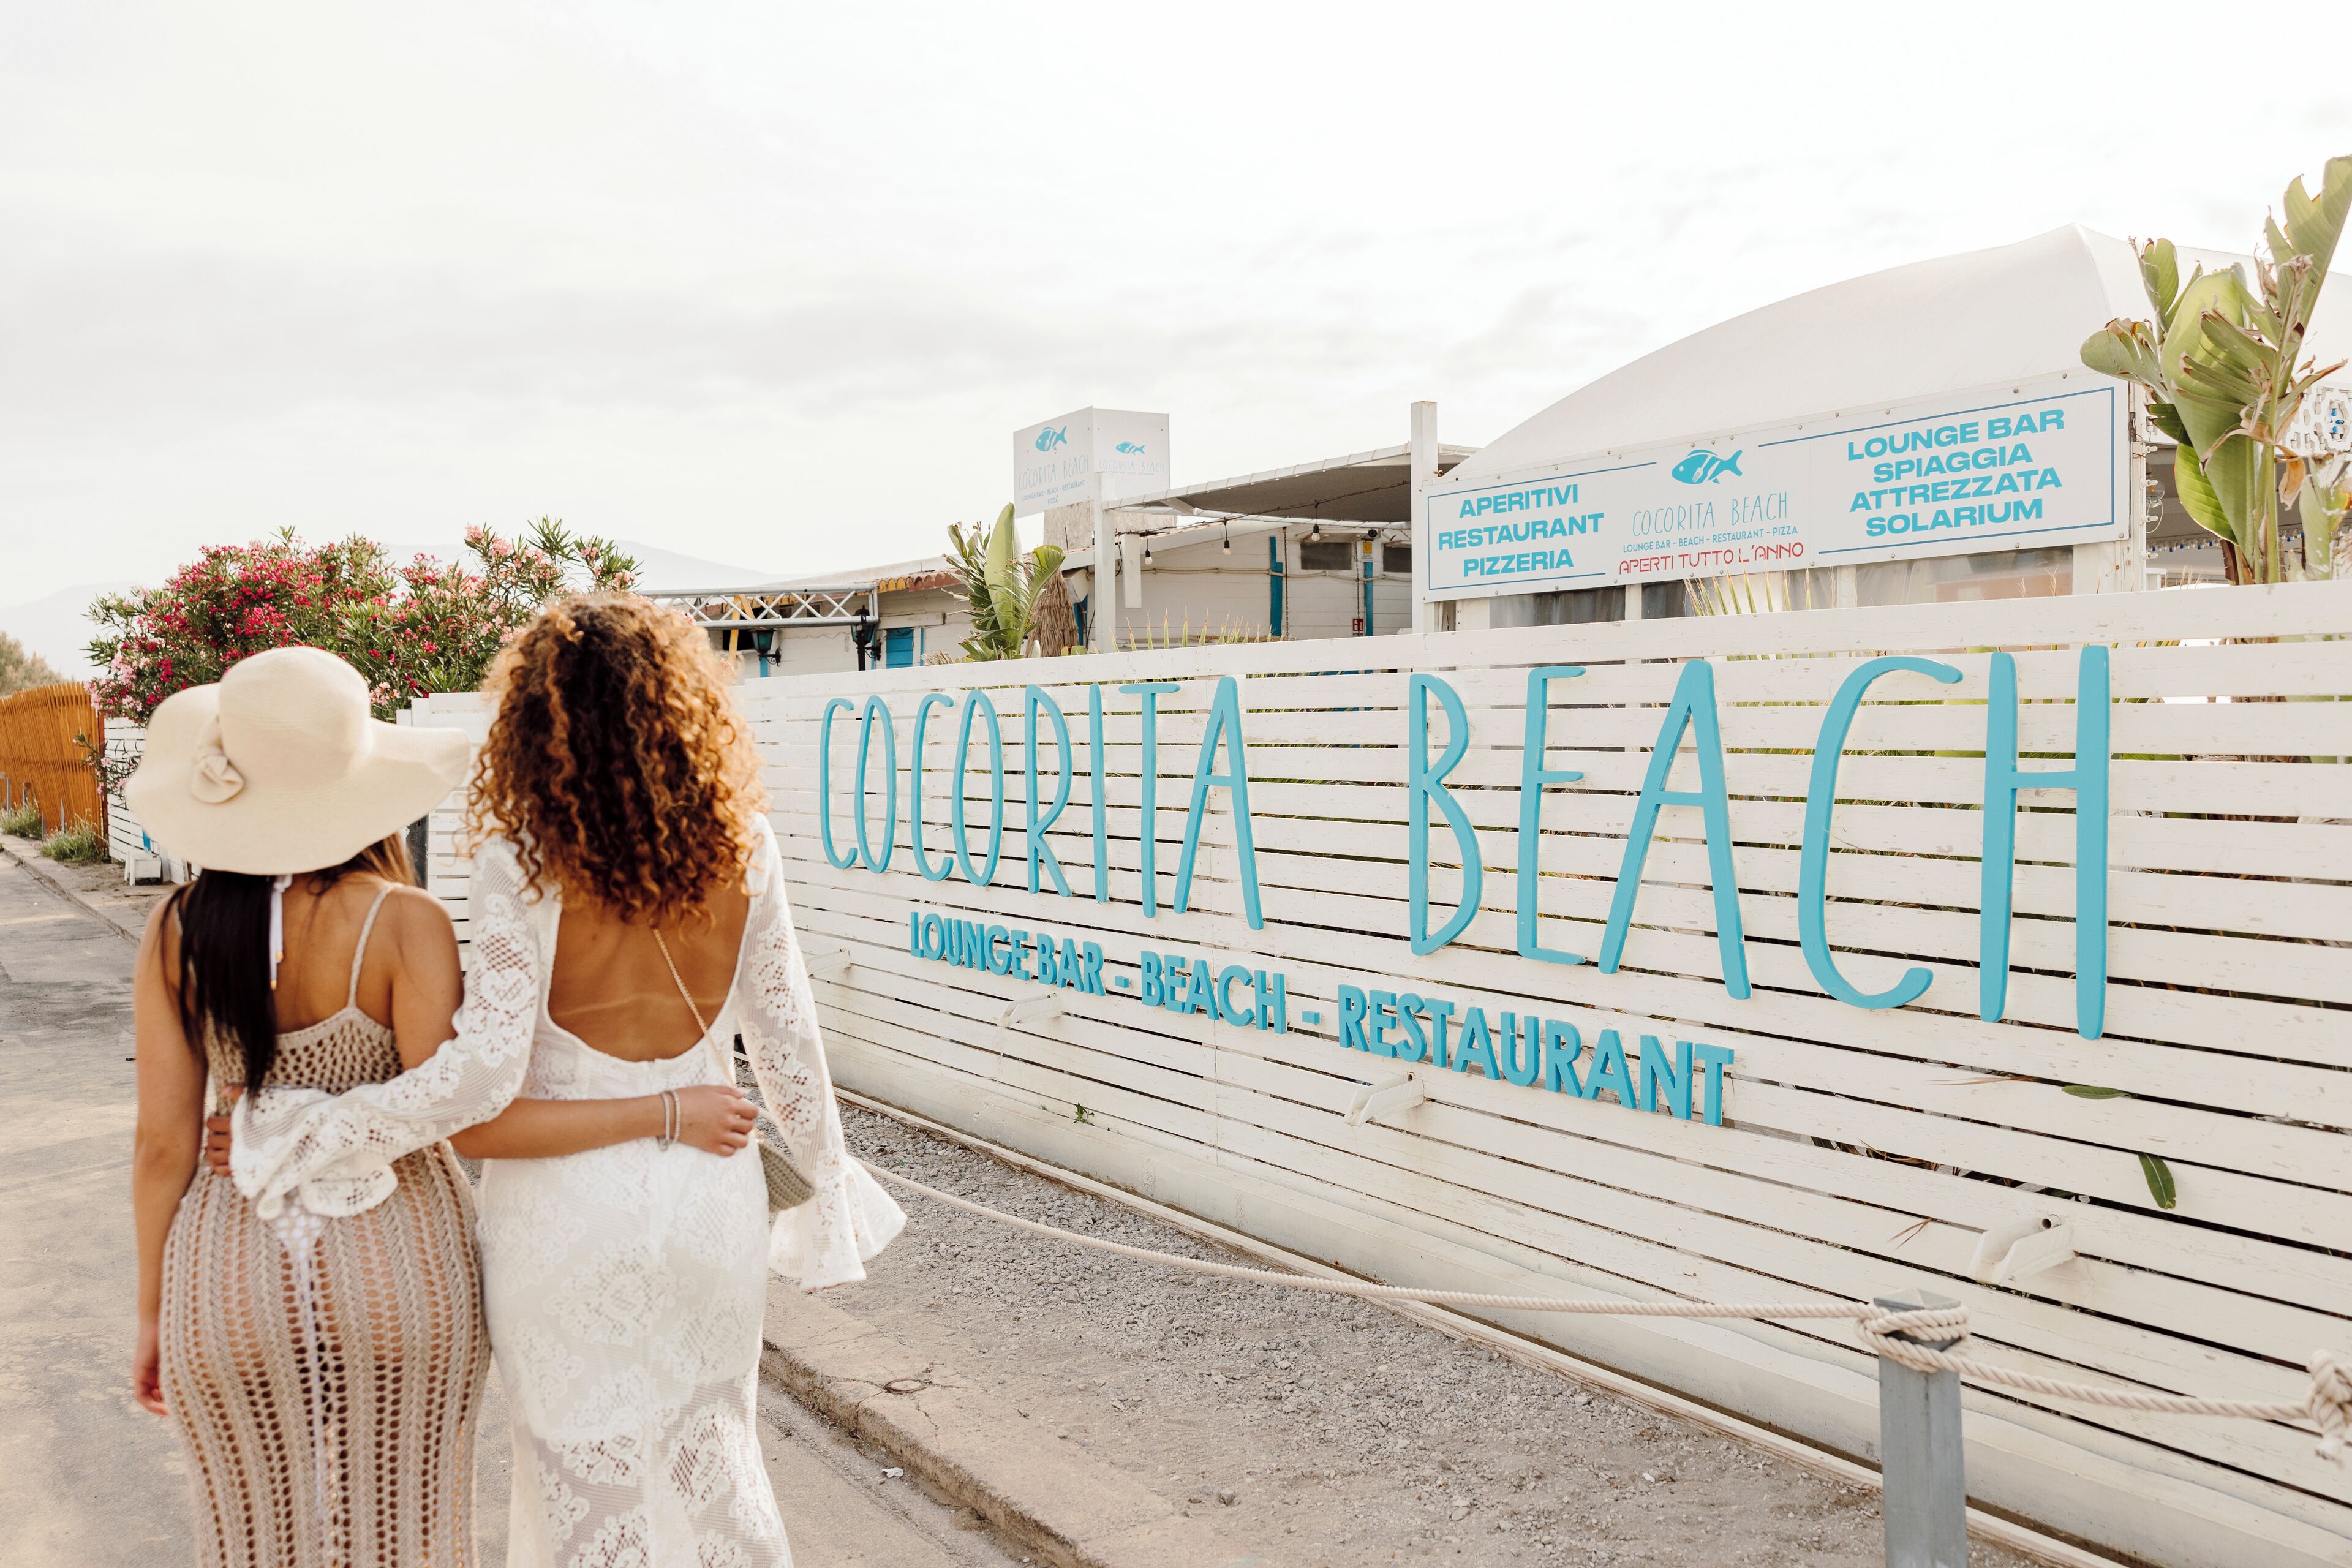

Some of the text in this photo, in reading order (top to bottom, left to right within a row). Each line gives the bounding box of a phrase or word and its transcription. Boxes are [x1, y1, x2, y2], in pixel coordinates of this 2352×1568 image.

[1848, 409, 2064, 461] LOUNGE BAR
[1019, 453, 1088, 490] COCORITA BEACH
[1873, 443, 2034, 483] SPIAGGIA
[1459, 484, 1578, 518] APERITIVI
[1850, 467, 2063, 512] ATTREZZATA
[1439, 513, 1604, 550] RESTAURANT
[1632, 491, 1787, 537] COCORITA BEACH
[1866, 498, 2043, 537] SOLARIUM
[1619, 542, 1804, 575] APERTI TUTTO L'ANNO
[1623, 541, 1653, 553] LOUNGE
[1656, 540, 1670, 549] BAR
[1679, 536, 1704, 547] BEACH
[1713, 529, 1764, 543] RESTAURANT
[1773, 526, 1798, 537] PIZZA
[1464, 549, 1574, 577] PIZZERIA
[820, 645, 2111, 1042] COCORITA BEACH
[910, 911, 1029, 980] LOUNGE
[1036, 933, 1106, 996] BAR
[1140, 950, 1287, 1034] BEACH
[1338, 984, 1734, 1126] RESTAURANT
